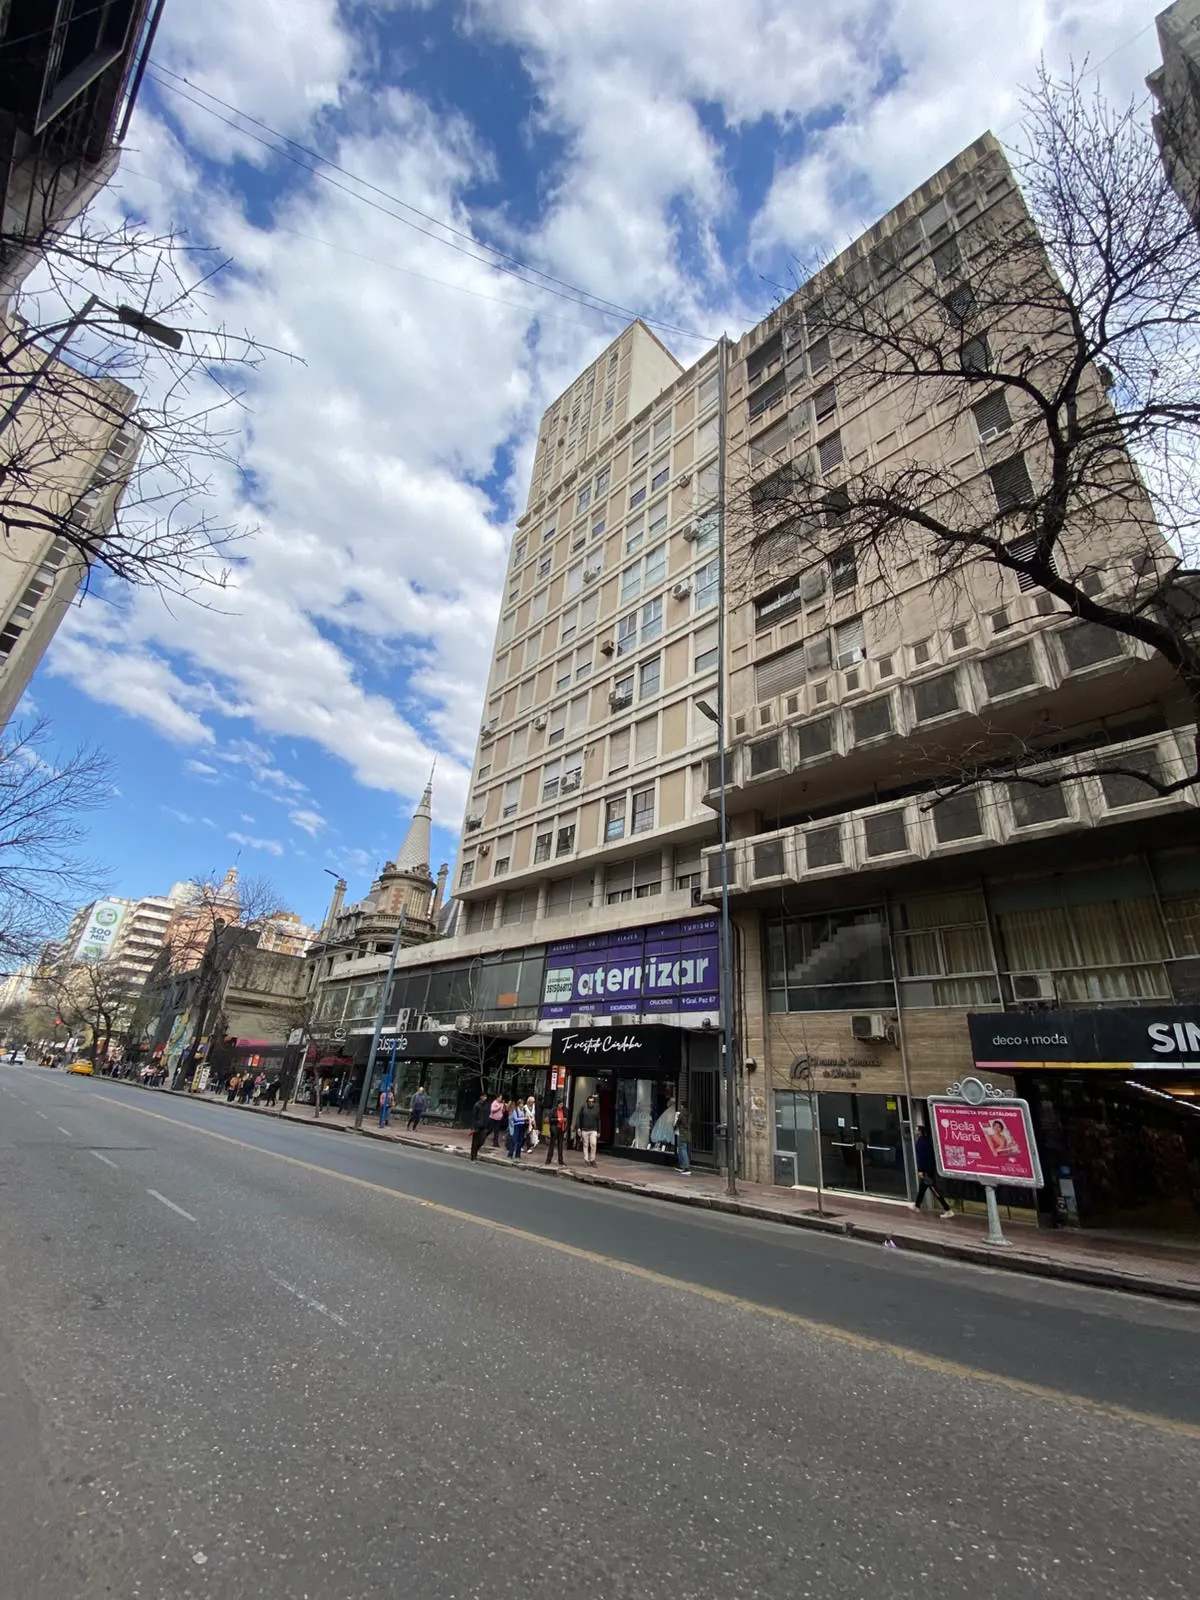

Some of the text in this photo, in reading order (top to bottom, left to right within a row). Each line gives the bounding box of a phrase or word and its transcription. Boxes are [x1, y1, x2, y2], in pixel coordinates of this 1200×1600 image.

[90, 927, 111, 936] 300
[683, 921, 715, 931] TURISMO
[577, 956, 709, 996] aterrizar
[993, 1035, 1022, 1045] deco
[1031, 1034, 1068, 1045] moda
[950, 1120, 975, 1132] Bella
